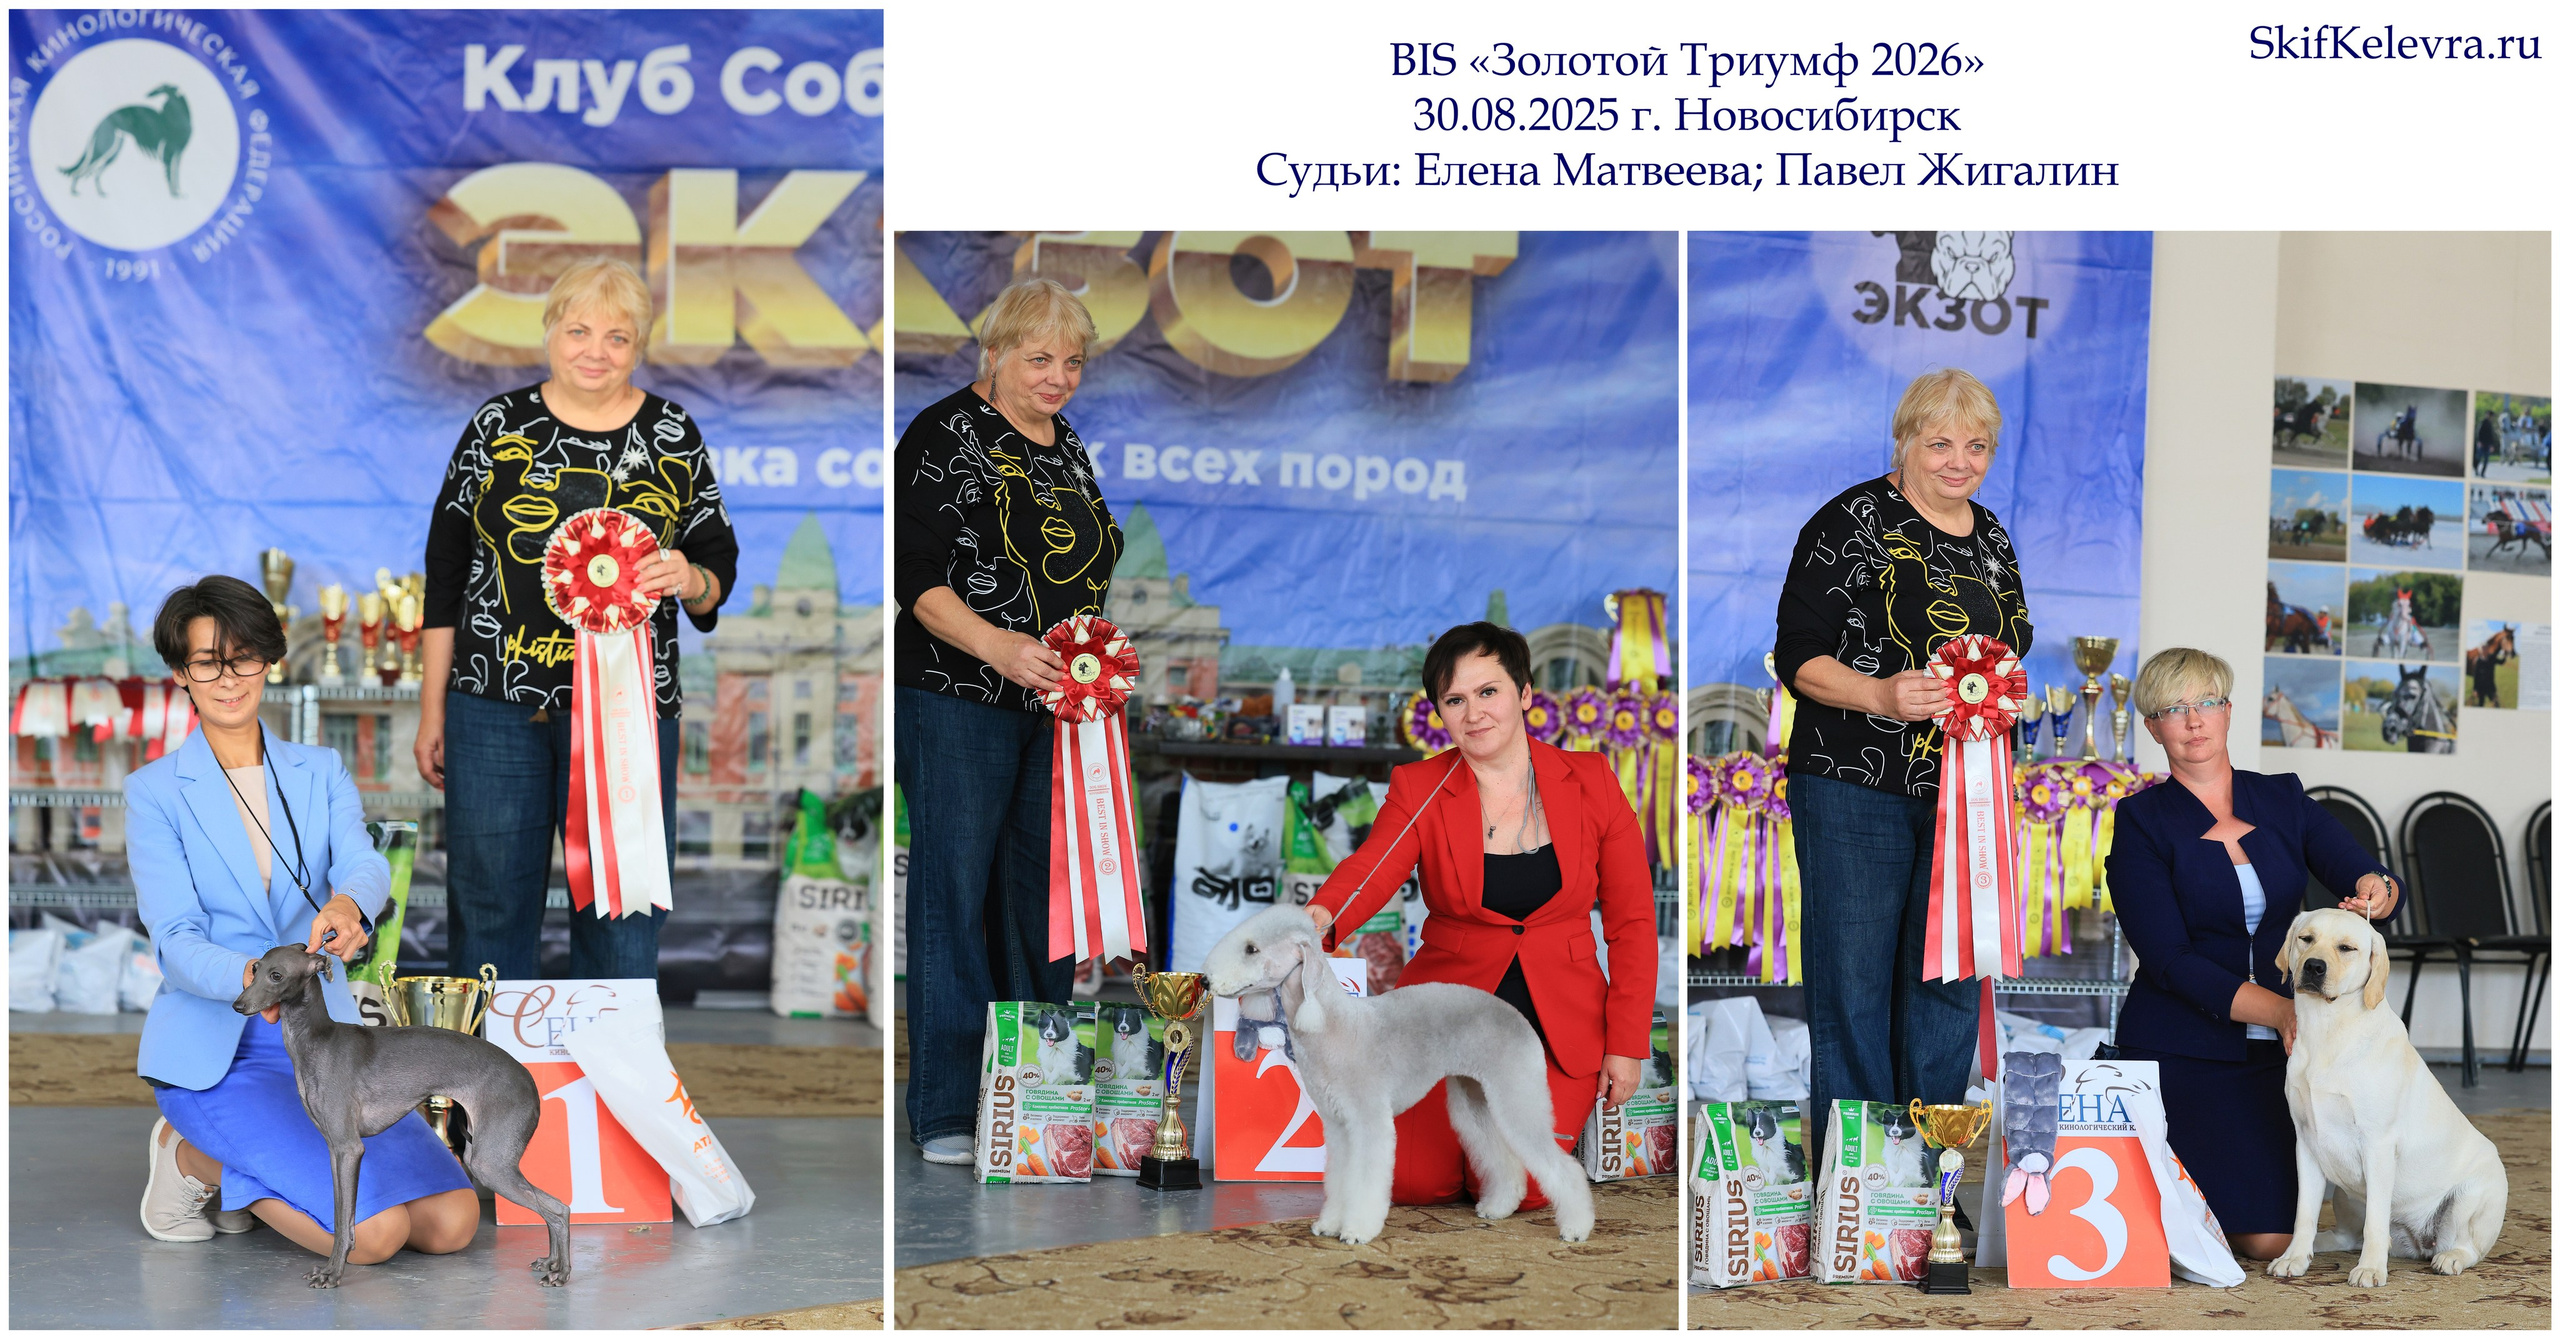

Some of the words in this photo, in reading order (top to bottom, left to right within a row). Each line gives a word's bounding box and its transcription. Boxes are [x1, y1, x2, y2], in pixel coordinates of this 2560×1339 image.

[463, 44, 695, 127] Клуб
[720, 46, 884, 117] Соб
[26, 9, 260, 100] КИНОЛОГИЧЕСКАЯ
[192, 108, 272, 264] ФЕДЕРАЦИЯ
[105, 257, 161, 282] 1991
[424, 162, 884, 368] ЭК
[1852, 280, 2050, 340] ЭКЗОТ
[1123, 443, 1262, 486] всех
[1280, 451, 1468, 502] пород
[1096, 797, 1107, 820] BEST
[1099, 821, 1108, 831] IN
[1976, 810, 1986, 833] BEST
[1100, 832, 1113, 857] SHOW
[1978, 834, 1987, 845] IN
[1104, 862, 1112, 871] 2
[1978, 846, 1989, 870] SHOW
[1980, 875, 1987, 885] 3
[1001, 1043, 1014, 1053] ADULT
[1022, 1071, 1041, 1080] 40%
[1025, 1088, 1059, 1096] ГОВЯДИНА
[989, 1075, 1016, 1167] SIRIUS
[1254, 1049, 1326, 1173] 2
[2059, 1123, 2128, 1132] КИНОЛОГИЧЕСКИЙ
[542, 1075, 625, 1214] 1
[1844, 1144, 1859, 1153] ADULT
[1746, 1173, 1762, 1183] 40%
[1867, 1172, 1886, 1182] 40%
[1753, 1191, 1782, 1199] ГОВЯДИНА
[1759, 1196, 1788, 1204] ОВОЩАМИ
[1833, 1176, 1861, 1273] SIRIUS
[2047, 1147, 2128, 1282] 3
[1694, 1195, 1705, 1263] SIRIUS
[1727, 1179, 1749, 1276] SIRIUS
